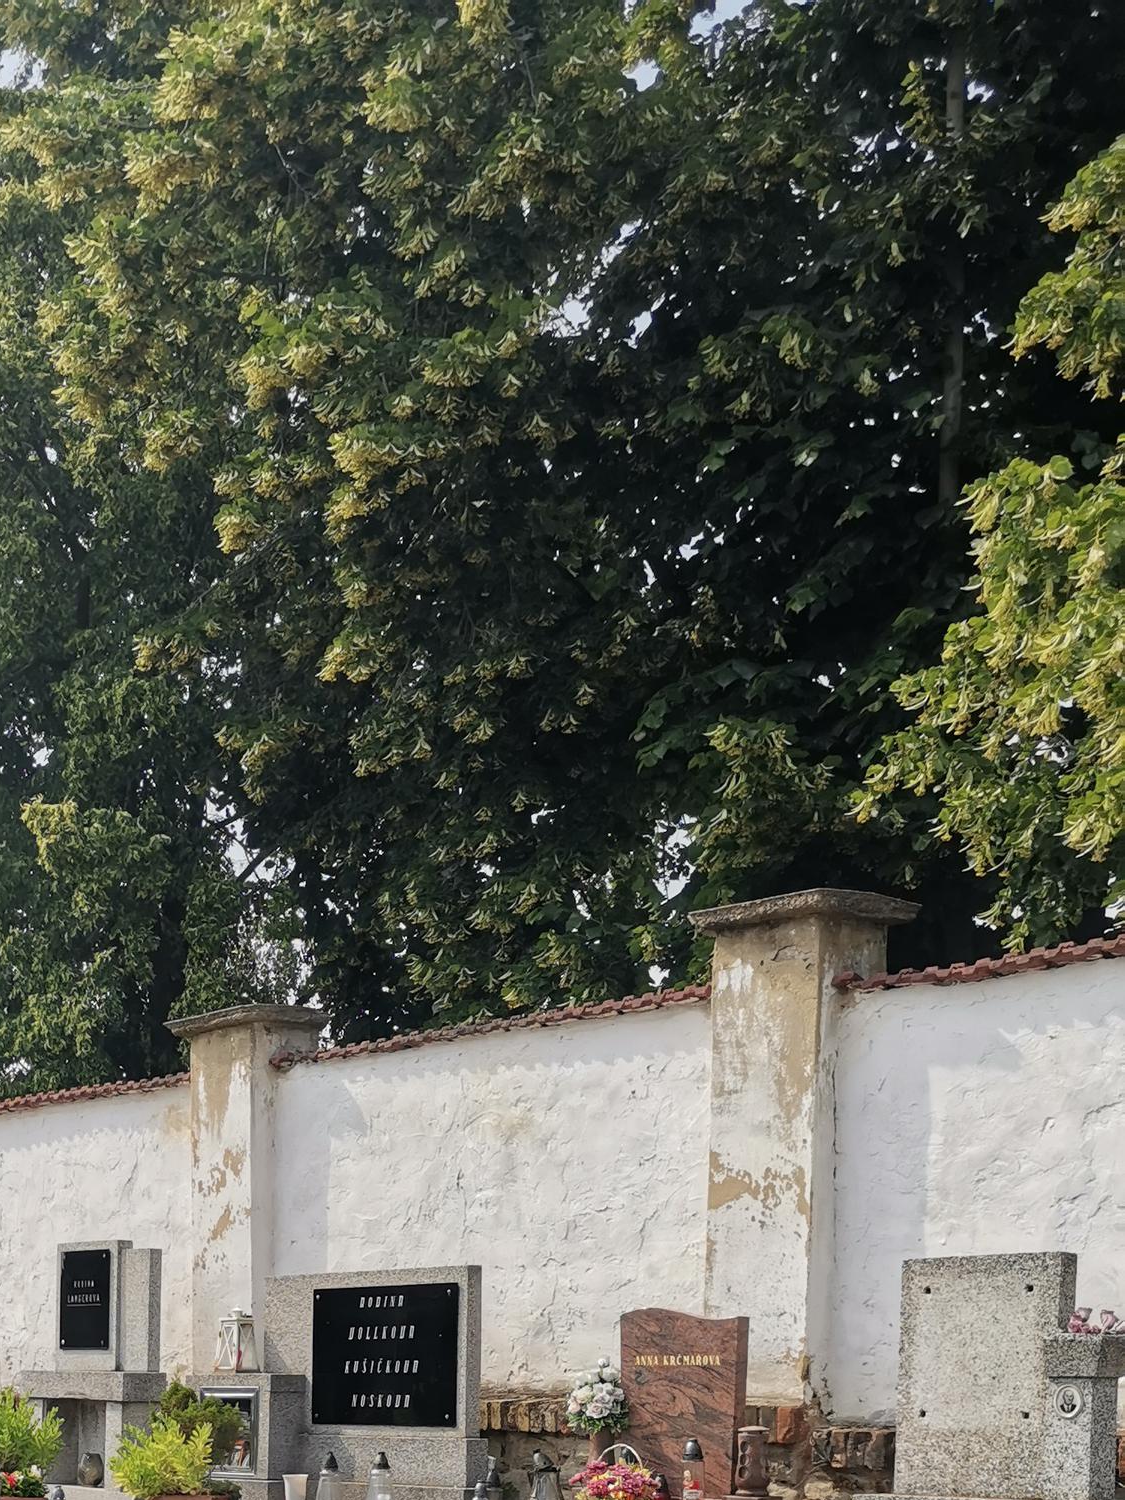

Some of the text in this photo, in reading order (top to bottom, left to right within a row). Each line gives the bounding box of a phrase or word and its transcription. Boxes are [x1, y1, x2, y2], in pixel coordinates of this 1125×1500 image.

[359, 1295, 404, 1308] RODINA
[635, 1355, 658, 1366] ANNA
[351, 1394, 410, 1408] NOSKOVA
